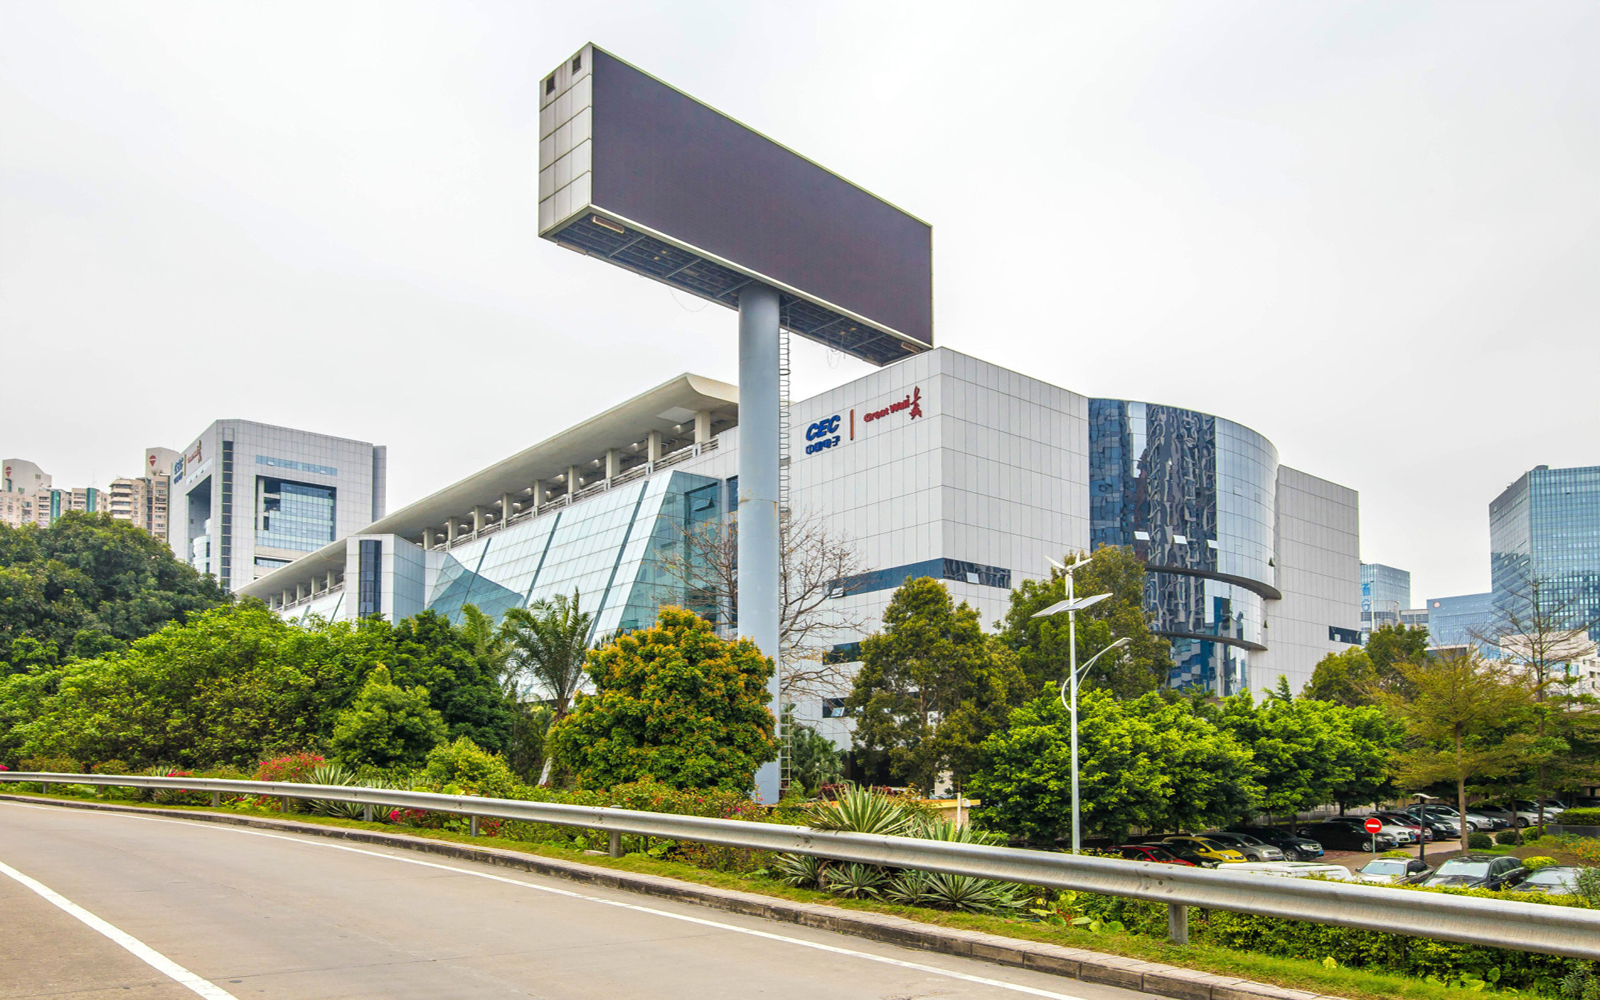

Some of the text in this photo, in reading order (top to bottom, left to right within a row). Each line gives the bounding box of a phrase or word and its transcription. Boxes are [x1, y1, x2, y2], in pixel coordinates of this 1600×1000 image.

[863, 407, 889, 422] Great
[889, 395, 910, 413] Wall
[806, 415, 841, 441] CEC
